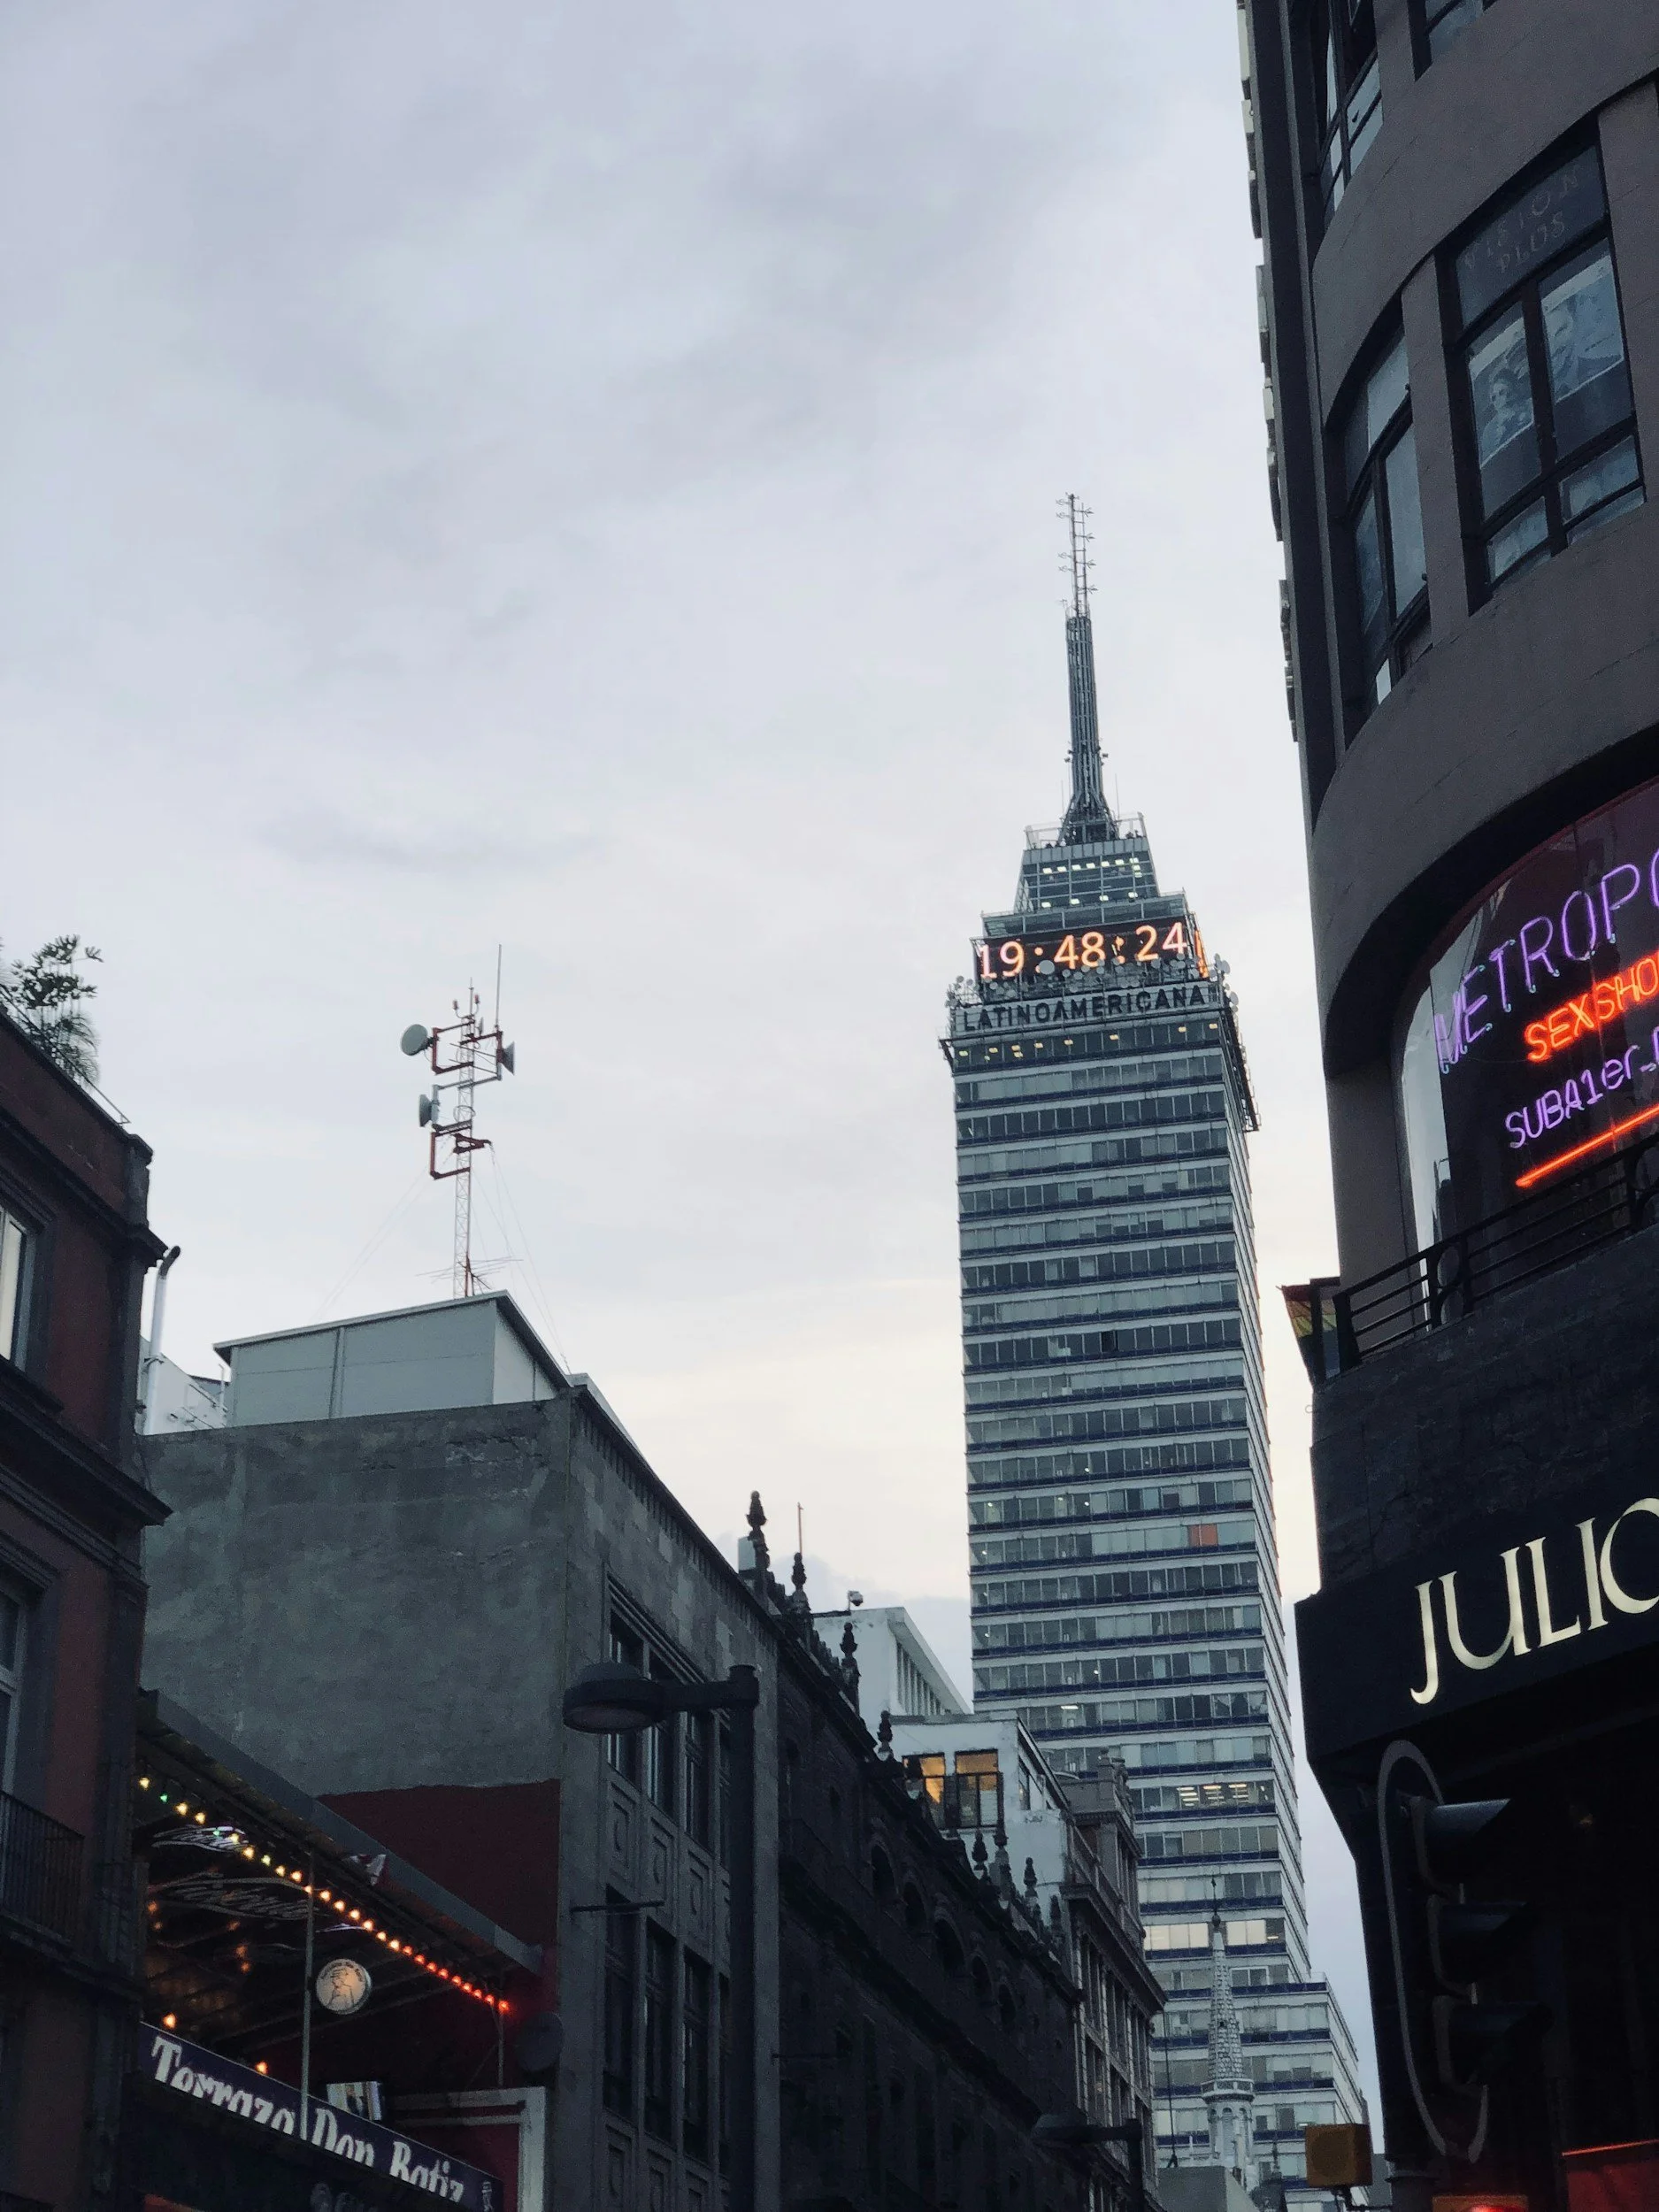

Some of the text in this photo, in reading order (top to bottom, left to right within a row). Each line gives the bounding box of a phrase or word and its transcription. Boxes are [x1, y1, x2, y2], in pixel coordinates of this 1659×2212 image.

[1499, 216, 1565, 273] PLUS
[979, 921, 1187, 979] 19:48:24
[1434, 848, 1659, 1074] METROP
[964, 984, 1206, 1032] LATINOAMERICANA
[1524, 949, 1659, 1063] SEXSHO
[311, 2106, 375, 2167] Don
